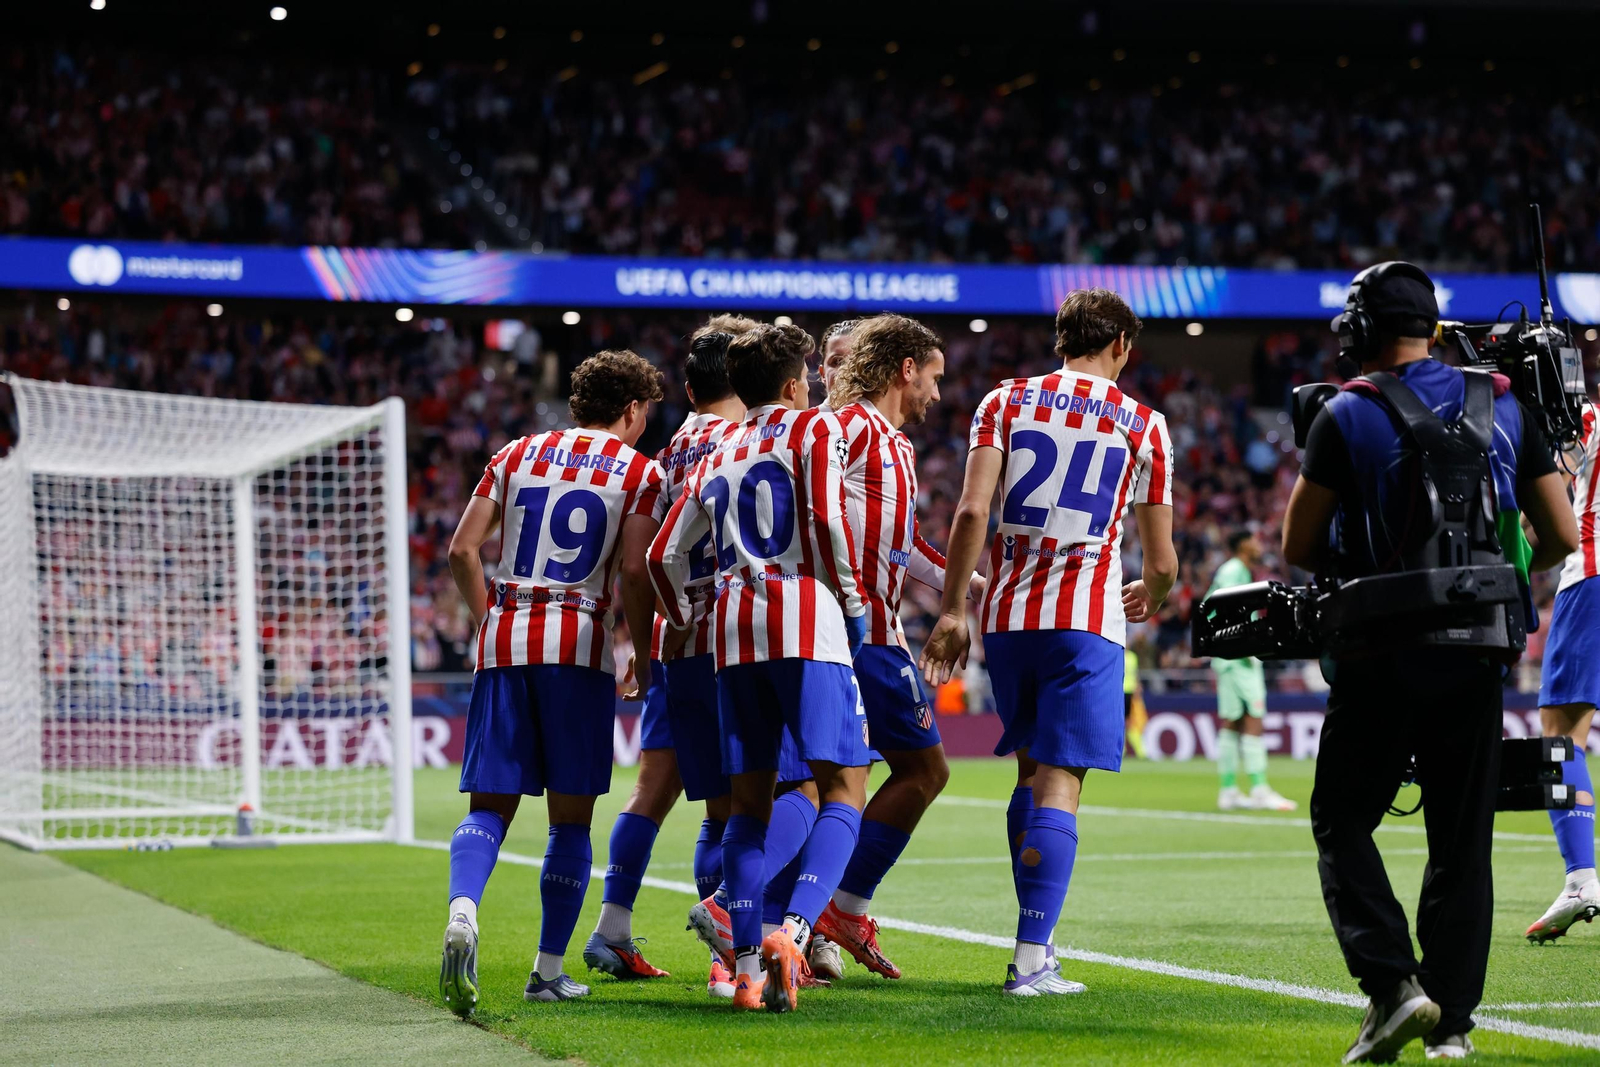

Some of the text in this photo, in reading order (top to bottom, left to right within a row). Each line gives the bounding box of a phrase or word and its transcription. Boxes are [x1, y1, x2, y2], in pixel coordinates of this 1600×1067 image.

[127, 257, 243, 281] mastercard
[615, 268, 960, 302] UEFA CHAMPIONS LEAGUE
[1010, 389, 1146, 433] LE NORMAND
[524, 445, 628, 477] J. ALVAREZ
[1002, 429, 1127, 538] 24
[701, 460, 795, 572] 20
[512, 486, 608, 584] 19
[891, 550, 910, 567] RIYA
[1022, 545, 1040, 558] Save
[1059, 547, 1101, 561] Children
[757, 571, 804, 581] Children
[510, 590, 598, 610] Save the Children
[456, 828, 495, 843] ATLETI
[543, 873, 582, 889] ATLETI
